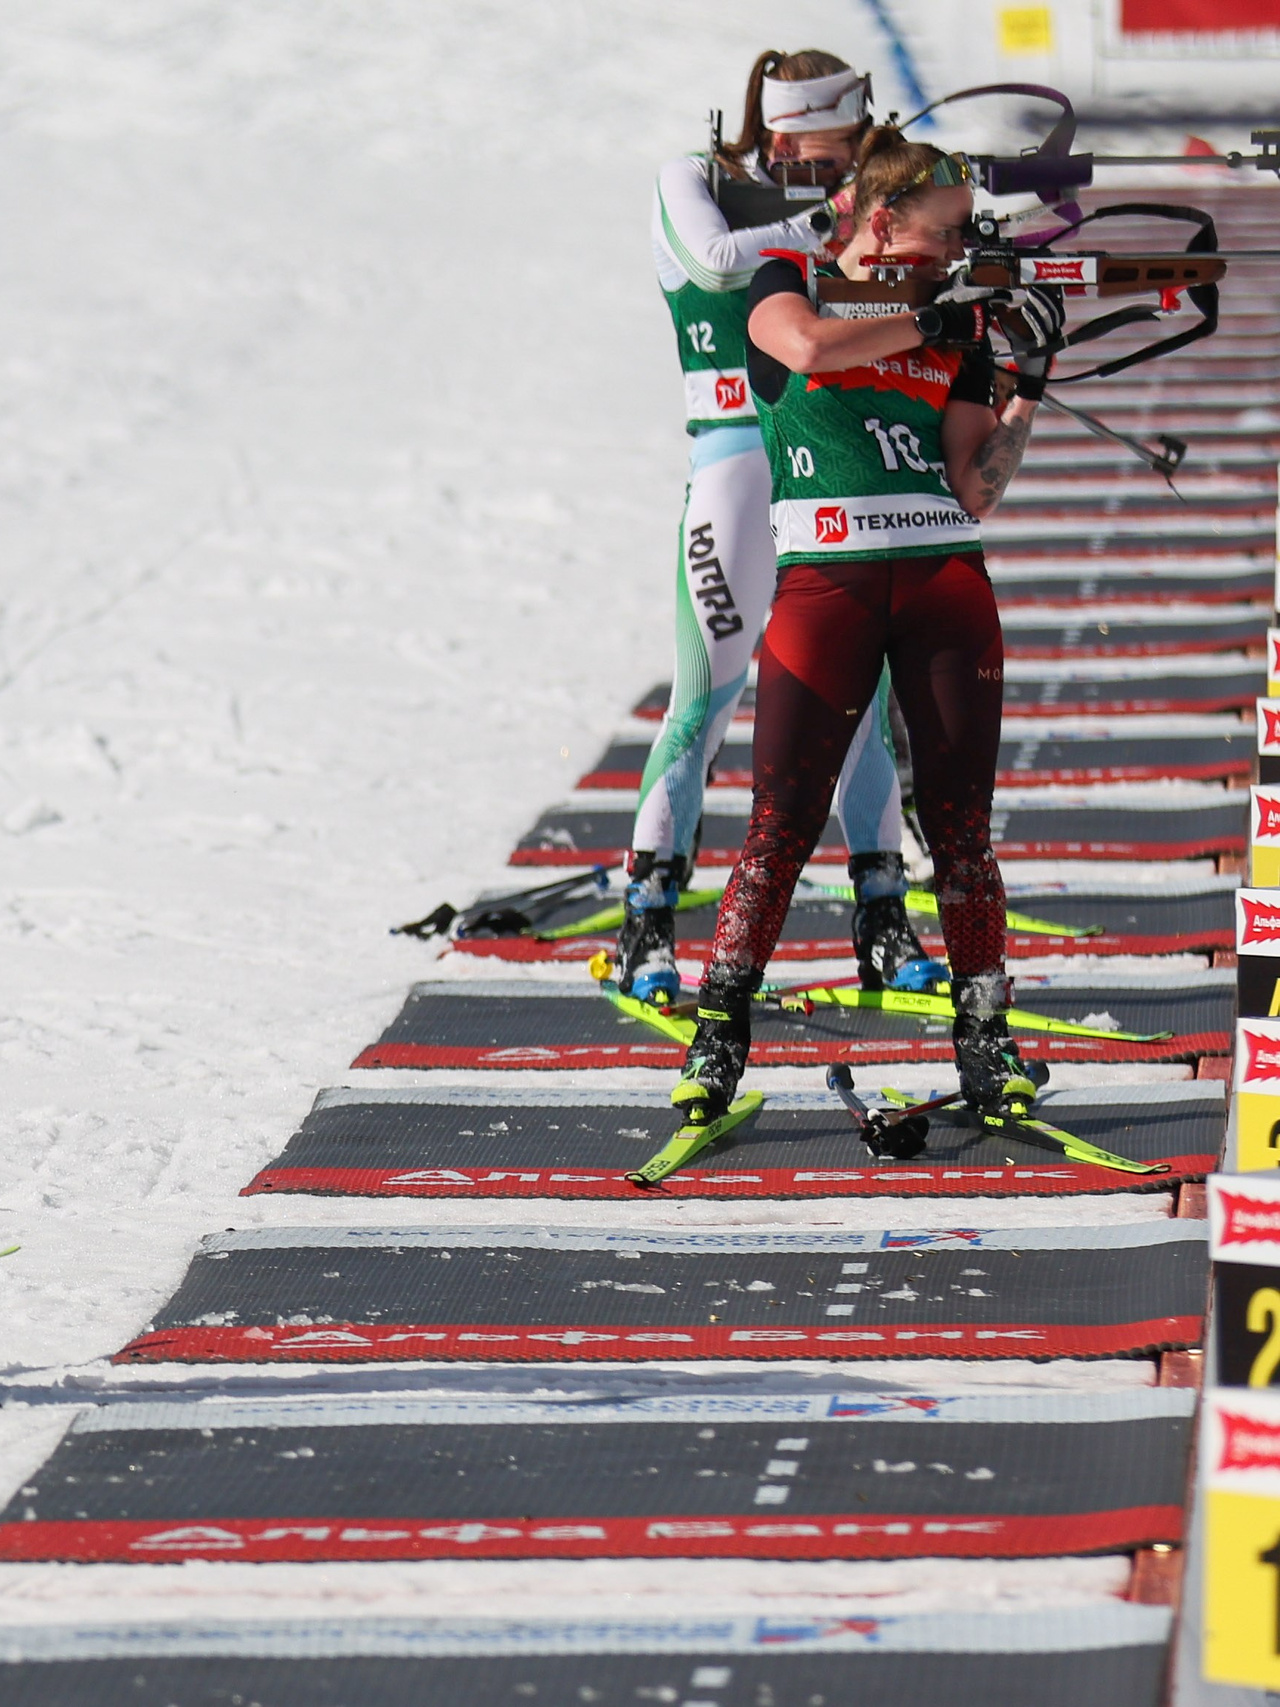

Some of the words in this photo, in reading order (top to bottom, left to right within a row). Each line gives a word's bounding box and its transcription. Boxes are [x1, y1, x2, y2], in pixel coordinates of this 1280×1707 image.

[687, 320, 717, 353] 12
[907, 357, 951, 388] Банк
[864, 418, 929, 473] 10
[787, 446, 815, 479] 10
[893, 996, 931, 1006] FISCHER
[478, 1046, 818, 1061] Альа
[381, 1169, 763, 1185] Альфа
[793, 1170, 1078, 1182] Банк
[271, 1330, 694, 1349] Альфа
[729, 1330, 1046, 1342] Банк
[129, 1522, 606, 1551] Альфа
[646, 1520, 1005, 1538] Банк
